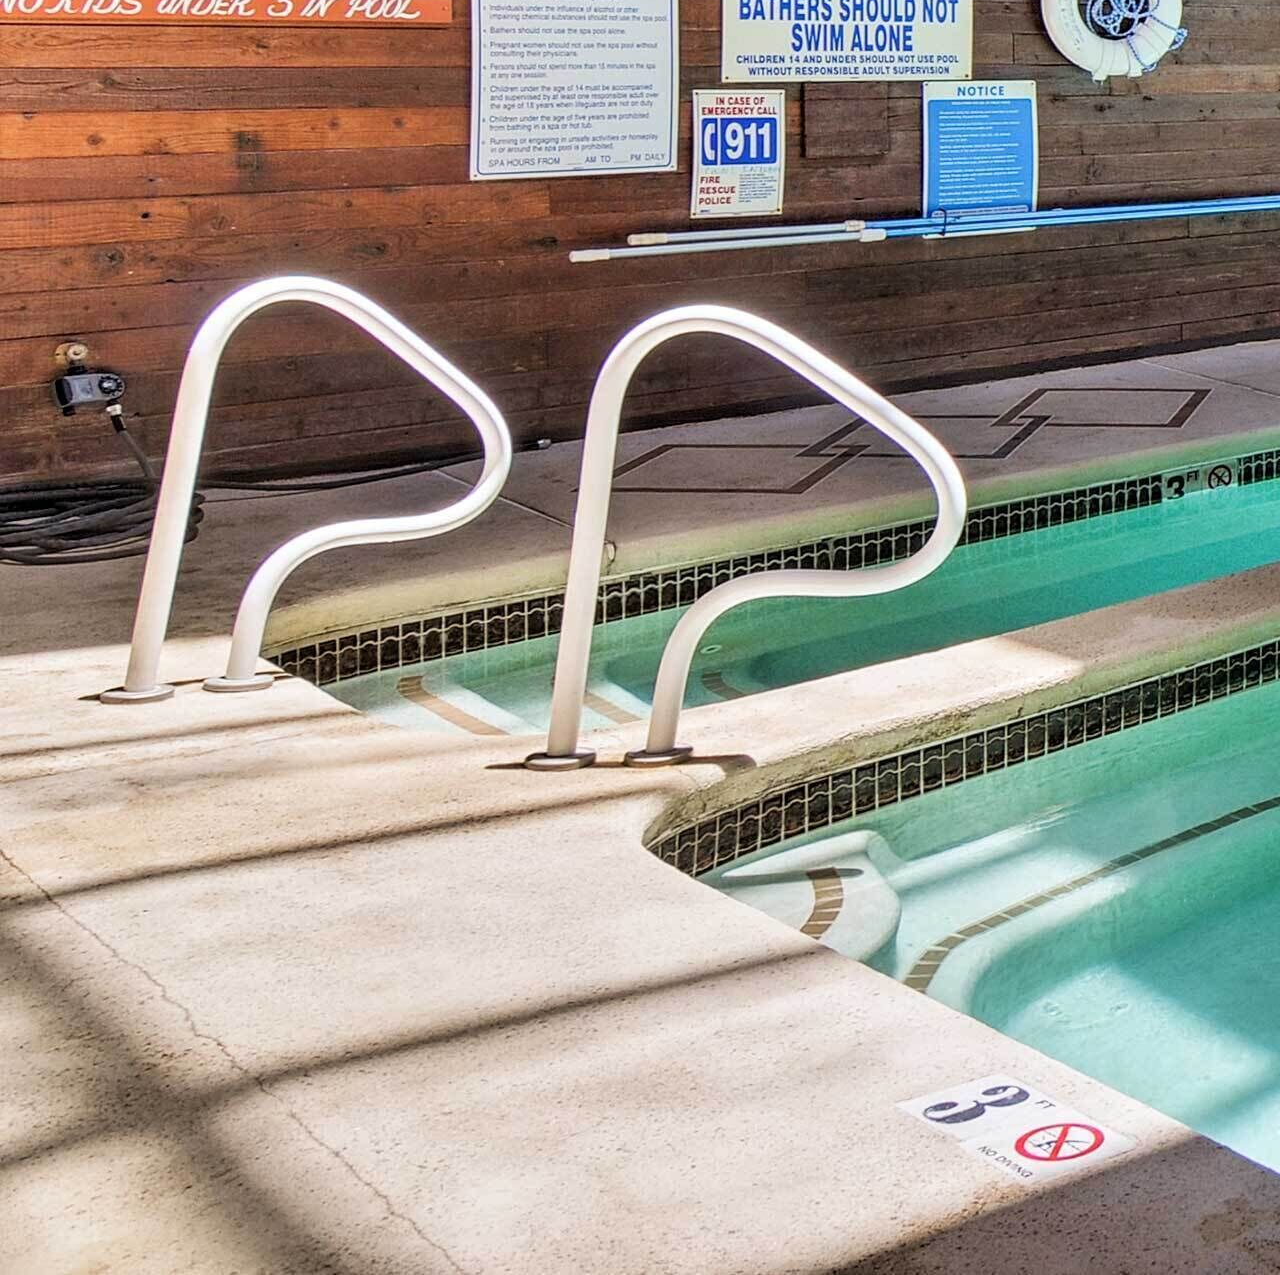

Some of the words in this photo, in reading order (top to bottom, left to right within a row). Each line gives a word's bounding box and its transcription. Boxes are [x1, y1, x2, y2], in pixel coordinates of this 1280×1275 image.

[791, 24, 844, 52] SWIM
[850, 24, 914, 52] ALONE
[736, 55, 785, 64] CHILDREN
[789, 55, 800, 64] 14
[803, 55, 822, 64] AND
[826, 55, 857, 64] UNDER
[859, 55, 895, 64] SHOULD
[898, 55, 915, 63] NOT
[917, 55, 934, 63] USE
[936, 55, 959, 63] POOL
[748, 67, 792, 75] WITHOUT
[795, 67, 859, 75] RESPONSIBLE
[862, 66, 890, 75] ADULT
[893, 66, 950, 74] SUPERVISION
[957, 86, 1005, 96] NOTICE
[727, 97, 751, 105] CASE
[753, 97, 765, 105] OF
[702, 107, 754, 115] EMERGENCY
[757, 107, 777, 115] CALL
[724, 122, 771, 160] 911
[489, 158, 505, 167] SPA
[507, 158, 535, 166] HOURS
[537, 157, 560, 165] FROM
[700, 176, 720, 184] FIRE
[699, 186, 736, 194] RESCUE
[1167, 475, 1185, 500] 3
[1187, 470, 1200, 481] FT
[922, 1085, 1030, 1124] 3
[1034, 1099, 1056, 1110] FT
[976, 1146, 998, 1157] NO
[995, 1155, 1033, 1178] DIVING
